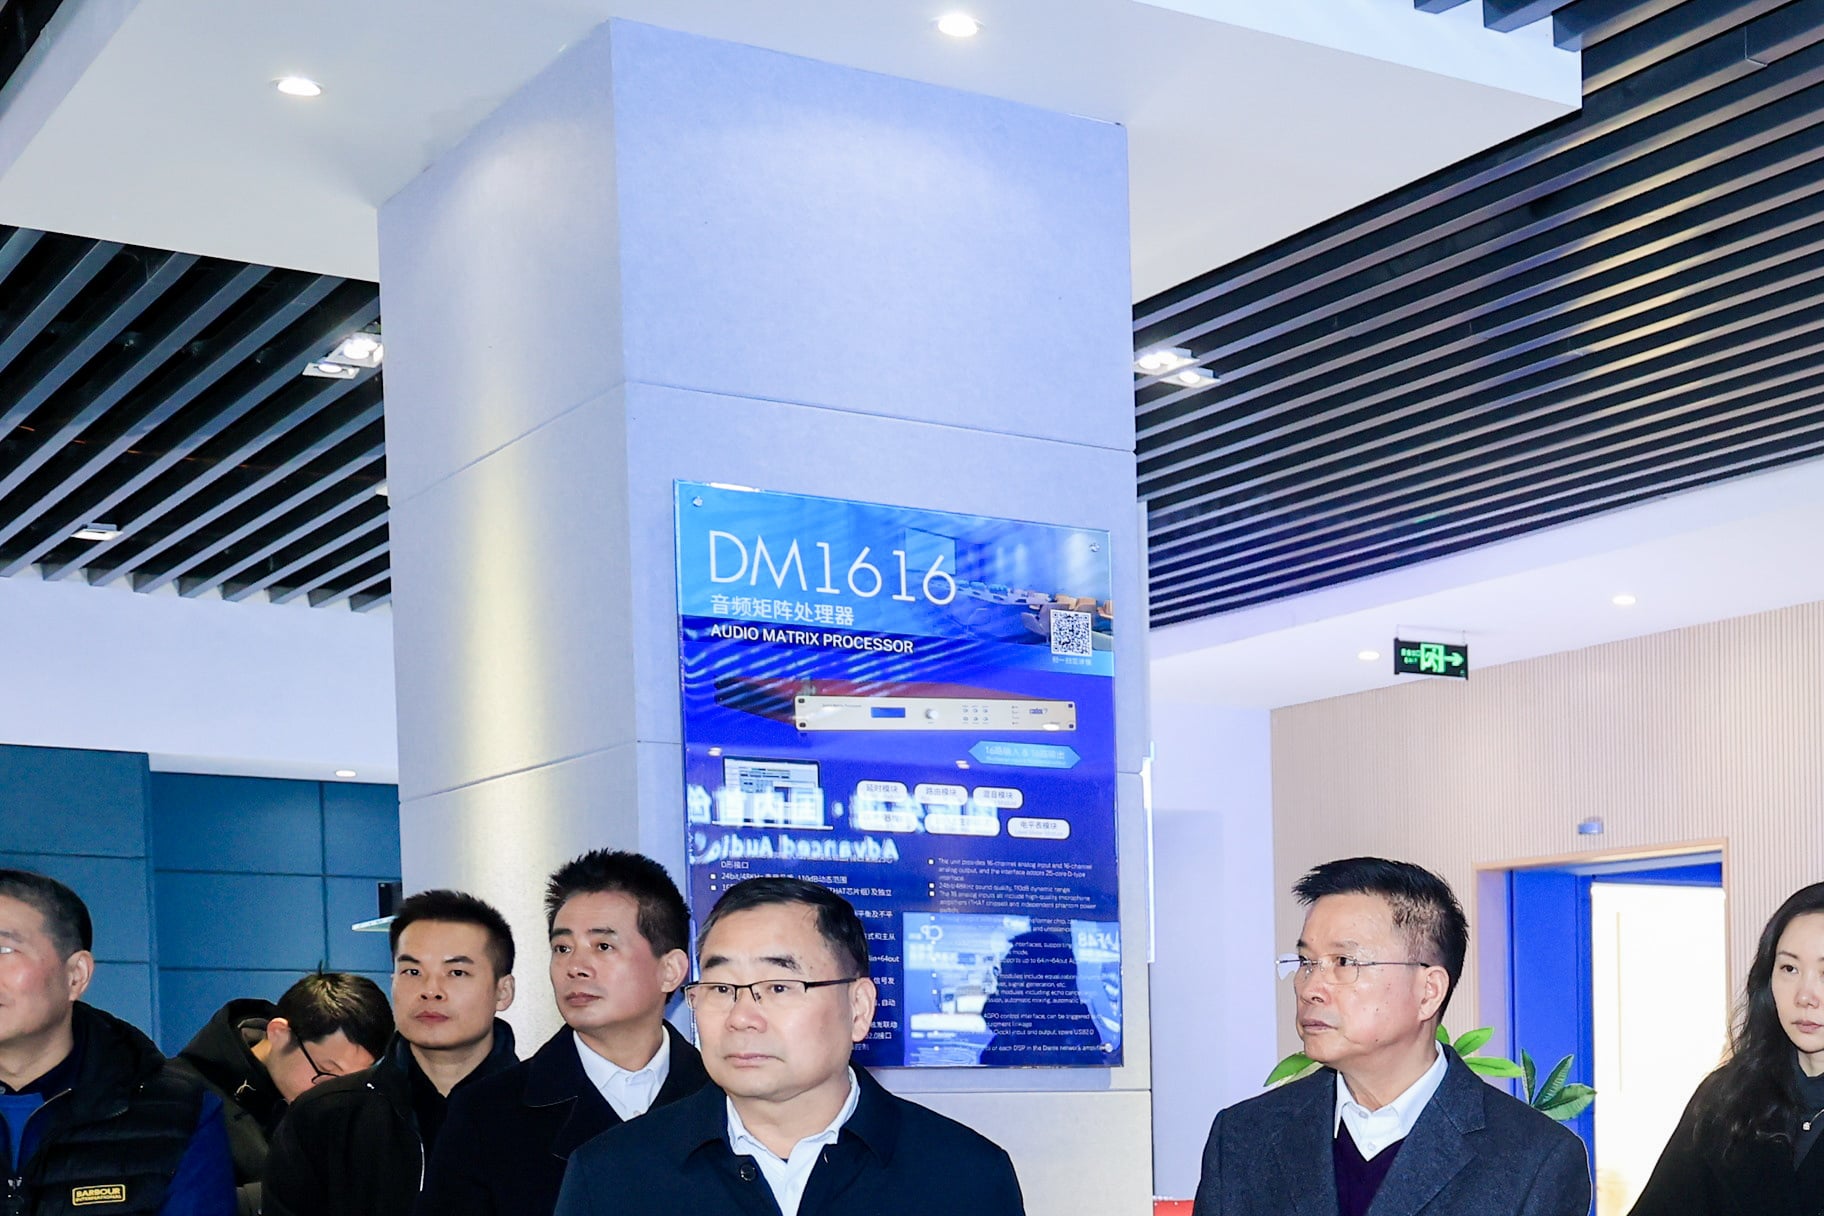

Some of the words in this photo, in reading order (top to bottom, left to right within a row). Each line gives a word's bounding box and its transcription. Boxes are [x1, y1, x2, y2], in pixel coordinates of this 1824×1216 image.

[709, 530, 957, 606] DM1616
[711, 594, 854, 626] 音频矩阵处理器
[711, 624, 759, 641] AUDIO
[763, 629, 819, 646] MATRIX
[823, 634, 914, 654] PROCESSOR
[76, 1187, 121, 1198] BARBOUR
